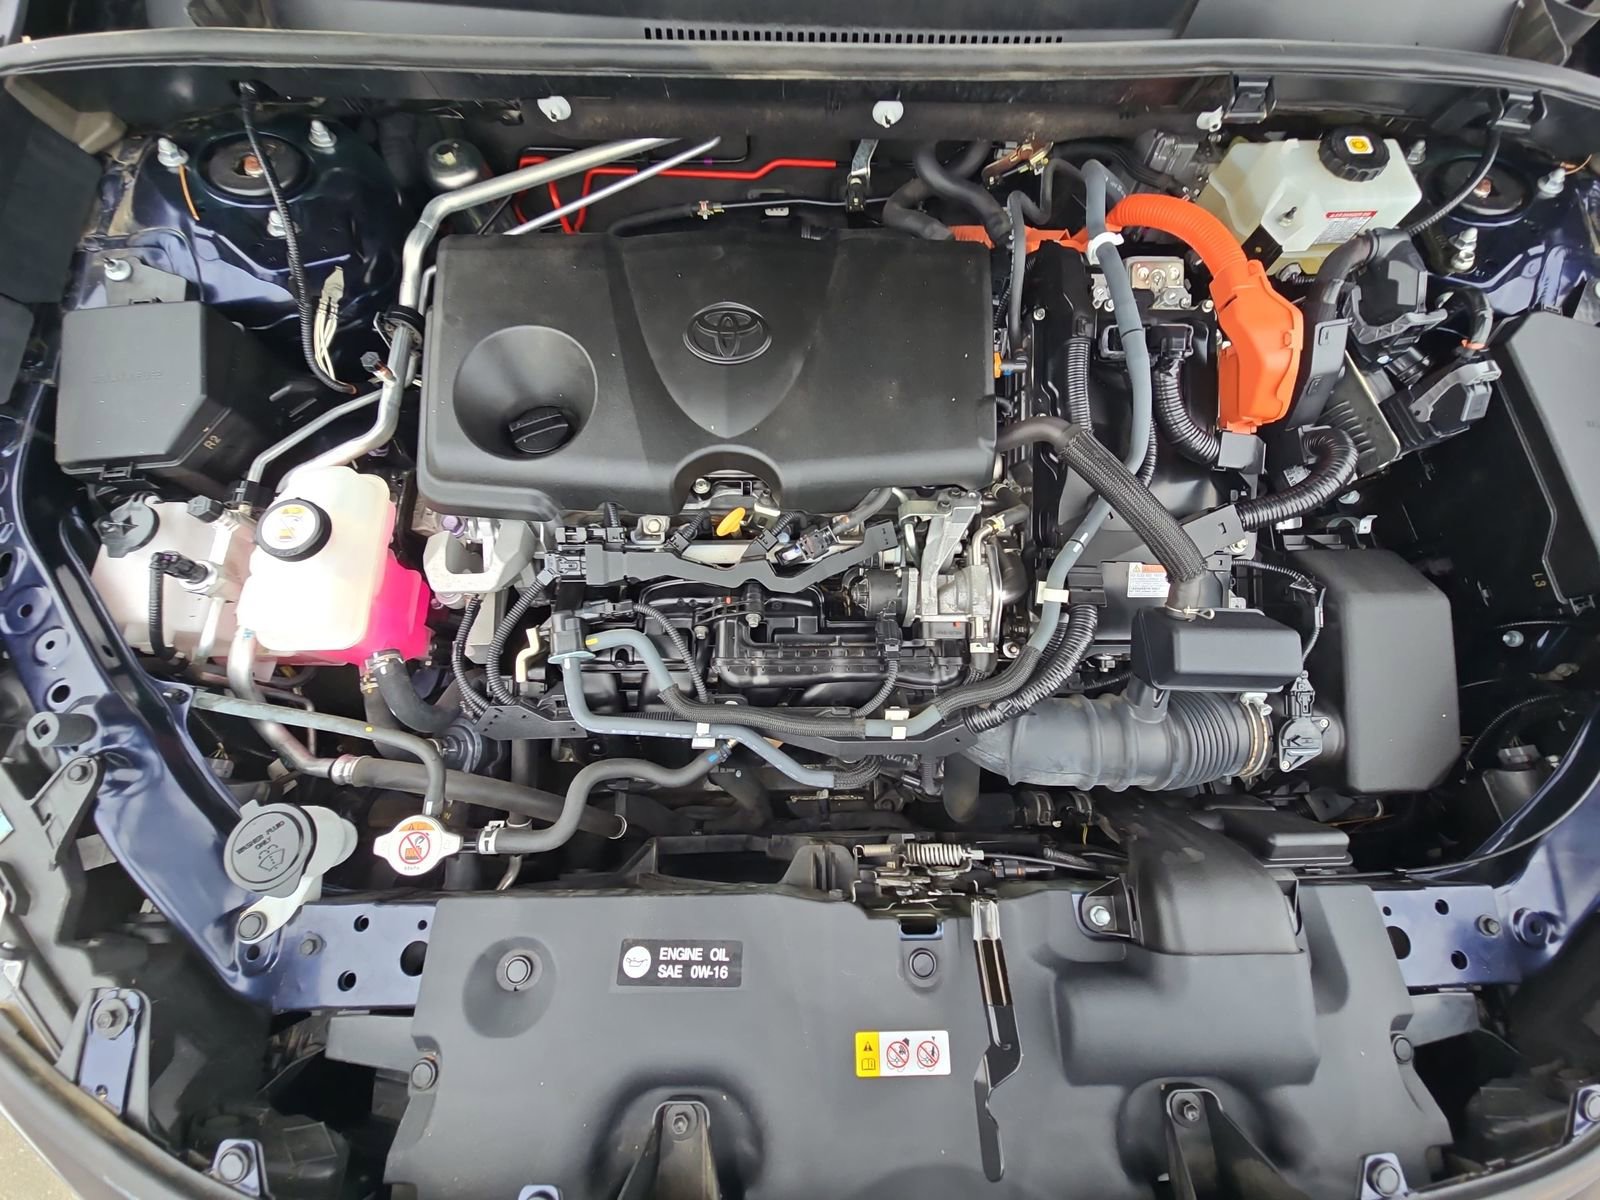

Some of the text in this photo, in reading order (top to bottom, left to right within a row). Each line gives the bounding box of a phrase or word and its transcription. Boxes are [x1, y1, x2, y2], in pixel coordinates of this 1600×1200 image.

[203, 435, 222, 450] R2
[1531, 572, 1547, 588] L3
[265, 820, 285, 835] FLUID
[254, 836, 272, 850] ONLY
[658, 947, 730, 961] ENGINE OIL
[656, 964, 729, 979] SAE 0W-16
